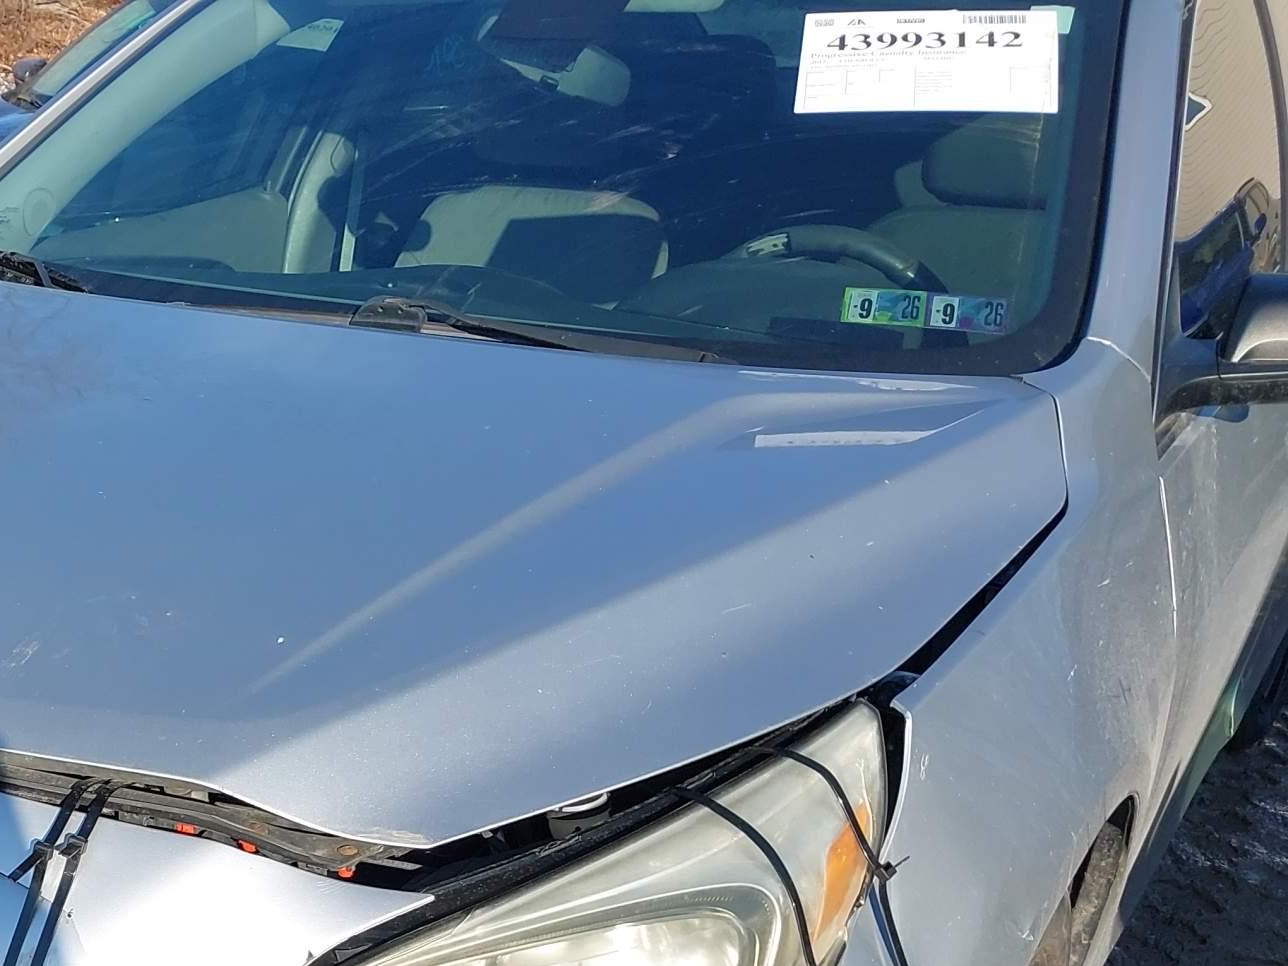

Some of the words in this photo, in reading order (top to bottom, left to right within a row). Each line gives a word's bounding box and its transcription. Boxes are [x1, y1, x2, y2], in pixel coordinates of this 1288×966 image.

[826, 31, 1023, 51] 43993142
[858, 298, 873, 319] 9
[901, 295, 920, 321] 26
[941, 303, 956, 325] 9
[984, 301, 1004, 327] 26
